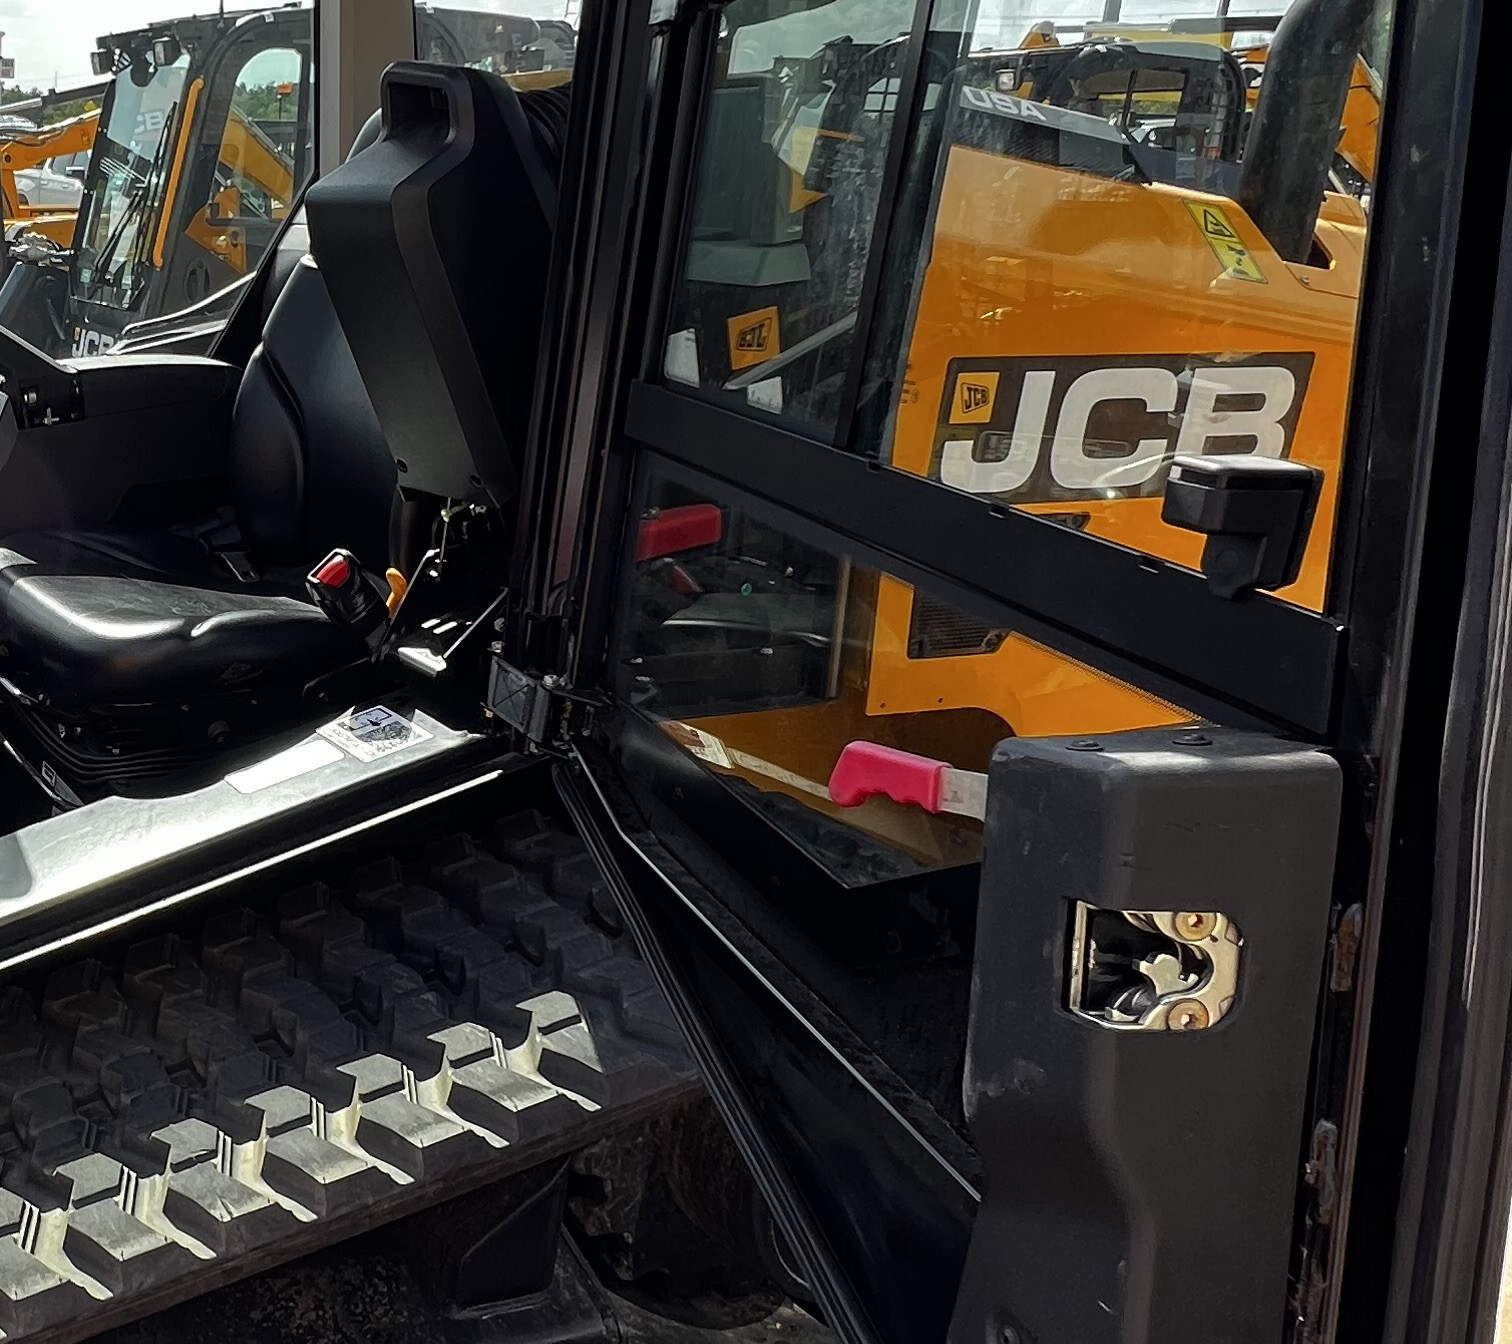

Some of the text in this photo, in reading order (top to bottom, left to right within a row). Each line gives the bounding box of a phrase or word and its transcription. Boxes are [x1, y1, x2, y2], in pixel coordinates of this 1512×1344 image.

[962, 88, 1048, 122] USA
[964, 385, 990, 409] JCB
[941, 366, 1296, 494] JCB
